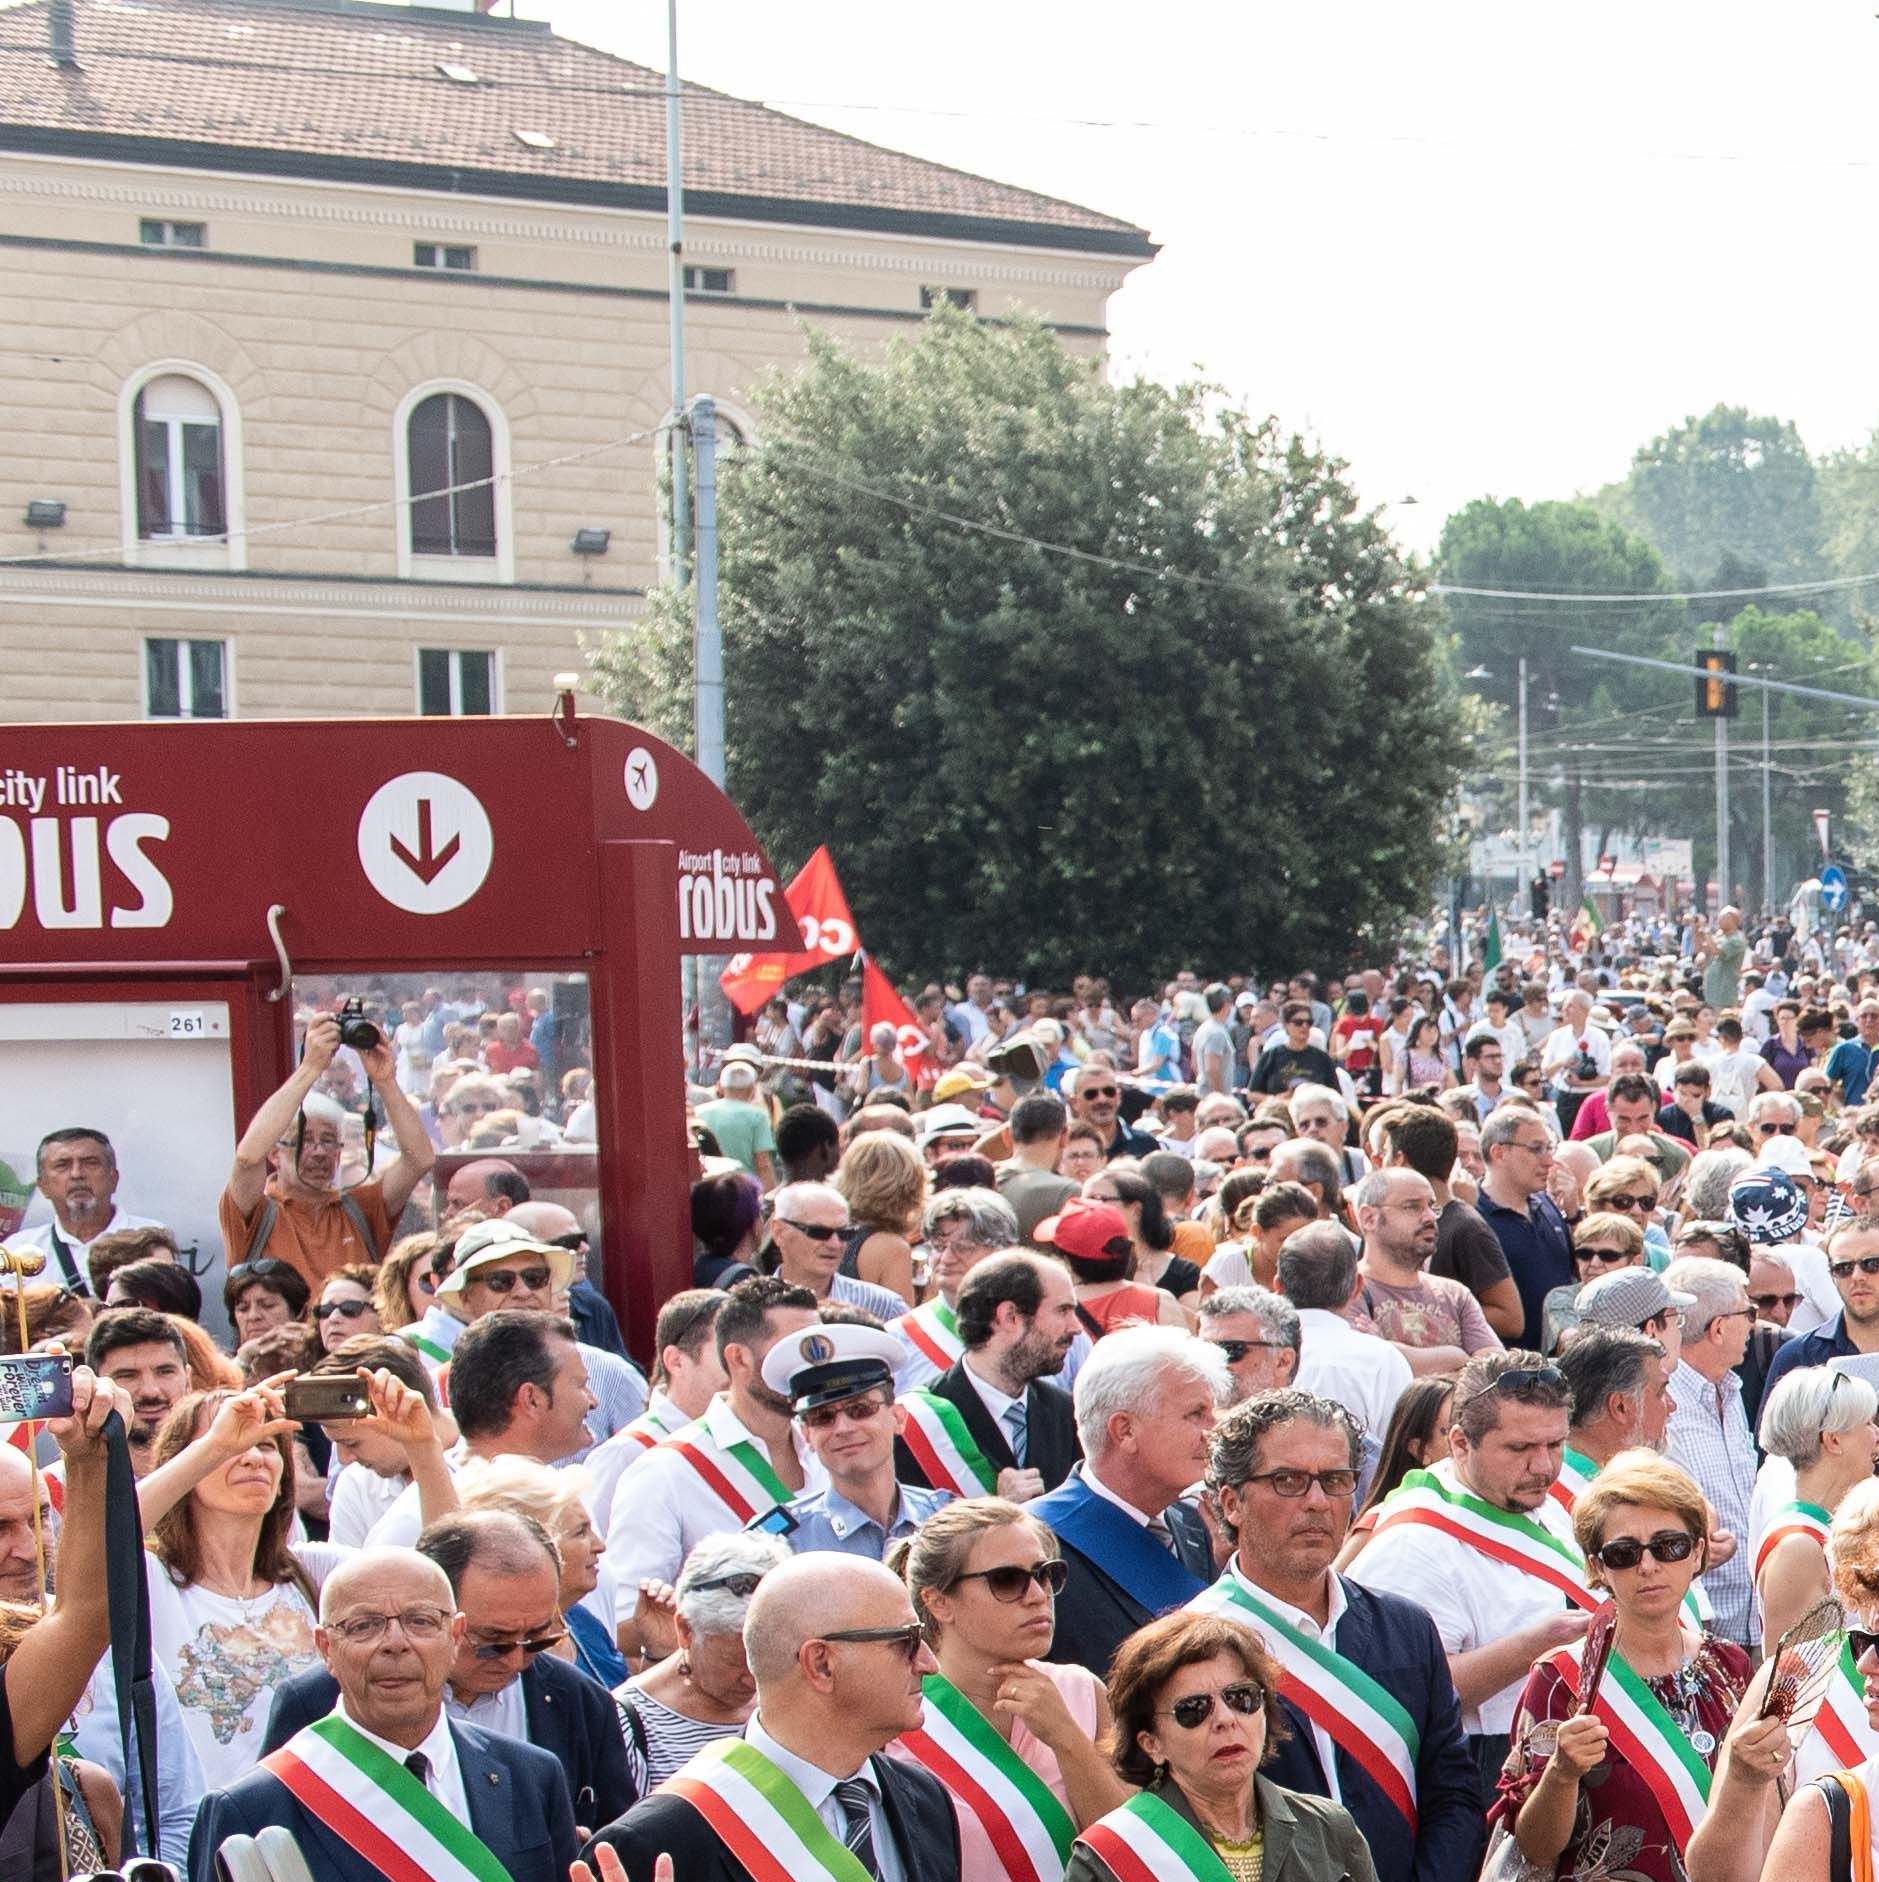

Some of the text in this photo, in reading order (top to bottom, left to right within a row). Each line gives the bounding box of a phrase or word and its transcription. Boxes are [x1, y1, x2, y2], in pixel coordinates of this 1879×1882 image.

[56, 766, 123, 805] link
[678, 850, 761, 876] Airport city link
[171, 1016, 202, 1032] 261
[1, 1363, 28, 1417] Forever
[25, 1360, 49, 1404] Dream
